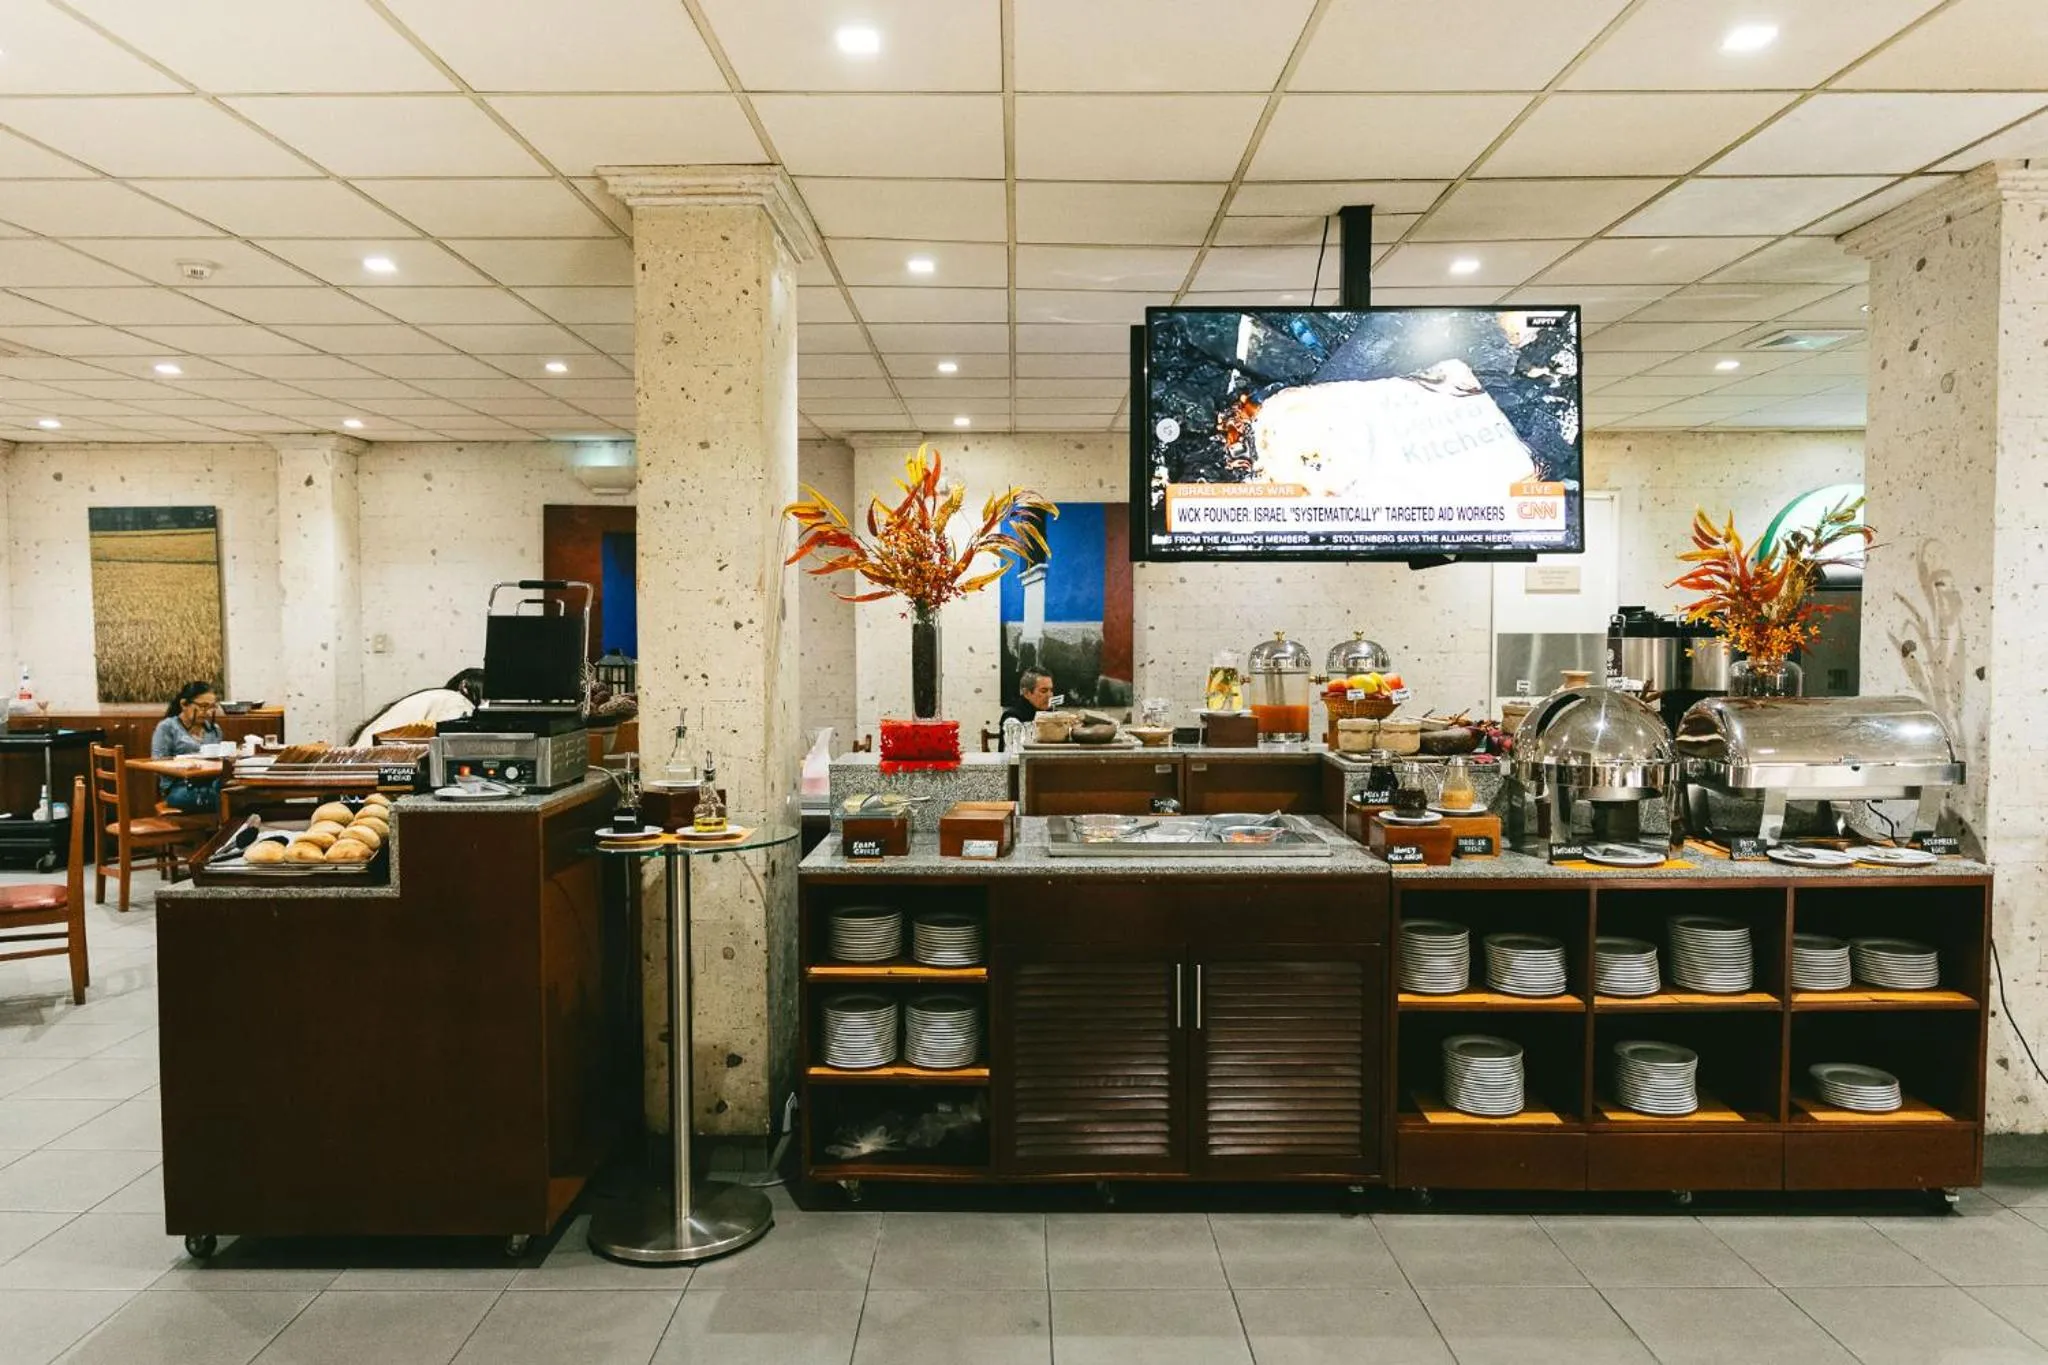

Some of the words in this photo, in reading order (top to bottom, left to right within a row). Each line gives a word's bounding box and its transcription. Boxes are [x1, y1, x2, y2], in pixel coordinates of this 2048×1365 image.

[1522, 484, 1552, 495] LIVE
[1178, 507, 1201, 522] WCK
[1204, 507, 1251, 522] FOUNDER:
[1254, 507, 1287, 522] ISRAEL
[1385, 507, 1434, 521] TARGETED
[1438, 506, 1454, 521] AID
[1456, 506, 1505, 521] WORKERS
[1517, 502, 1557, 520] CNN
[1174, 535, 1200, 544] FROM
[1202, 535, 1219, 544] THE
[1221, 535, 1264, 544] ALLIANCE
[1266, 535, 1310, 544] MEMBERS
[1332, 535, 1395, 543] STOLTENBERG
[1397, 535, 1420, 543] SAYS
[1422, 535, 1438, 543] THE
[1440, 535, 1484, 543] ALLIANCE
